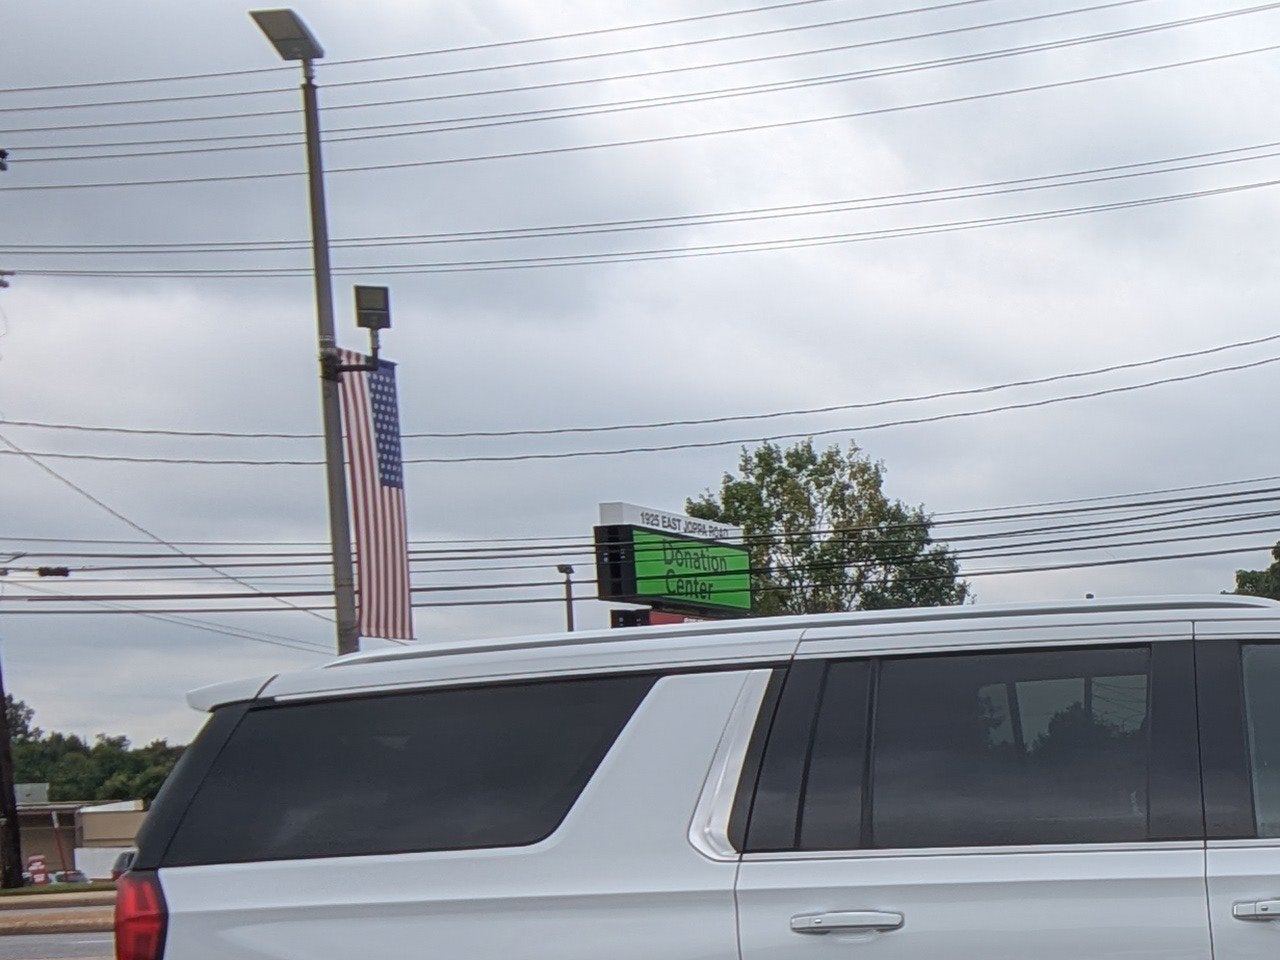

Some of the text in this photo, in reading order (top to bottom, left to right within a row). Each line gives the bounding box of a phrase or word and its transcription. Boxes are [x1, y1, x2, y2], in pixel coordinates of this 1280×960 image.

[640, 511, 660, 527] 1925
[661, 515, 681, 531] EAST
[684, 520, 707, 537] JOPPA
[663, 539, 728, 572] Donation
[665, 568, 714, 600] Center
